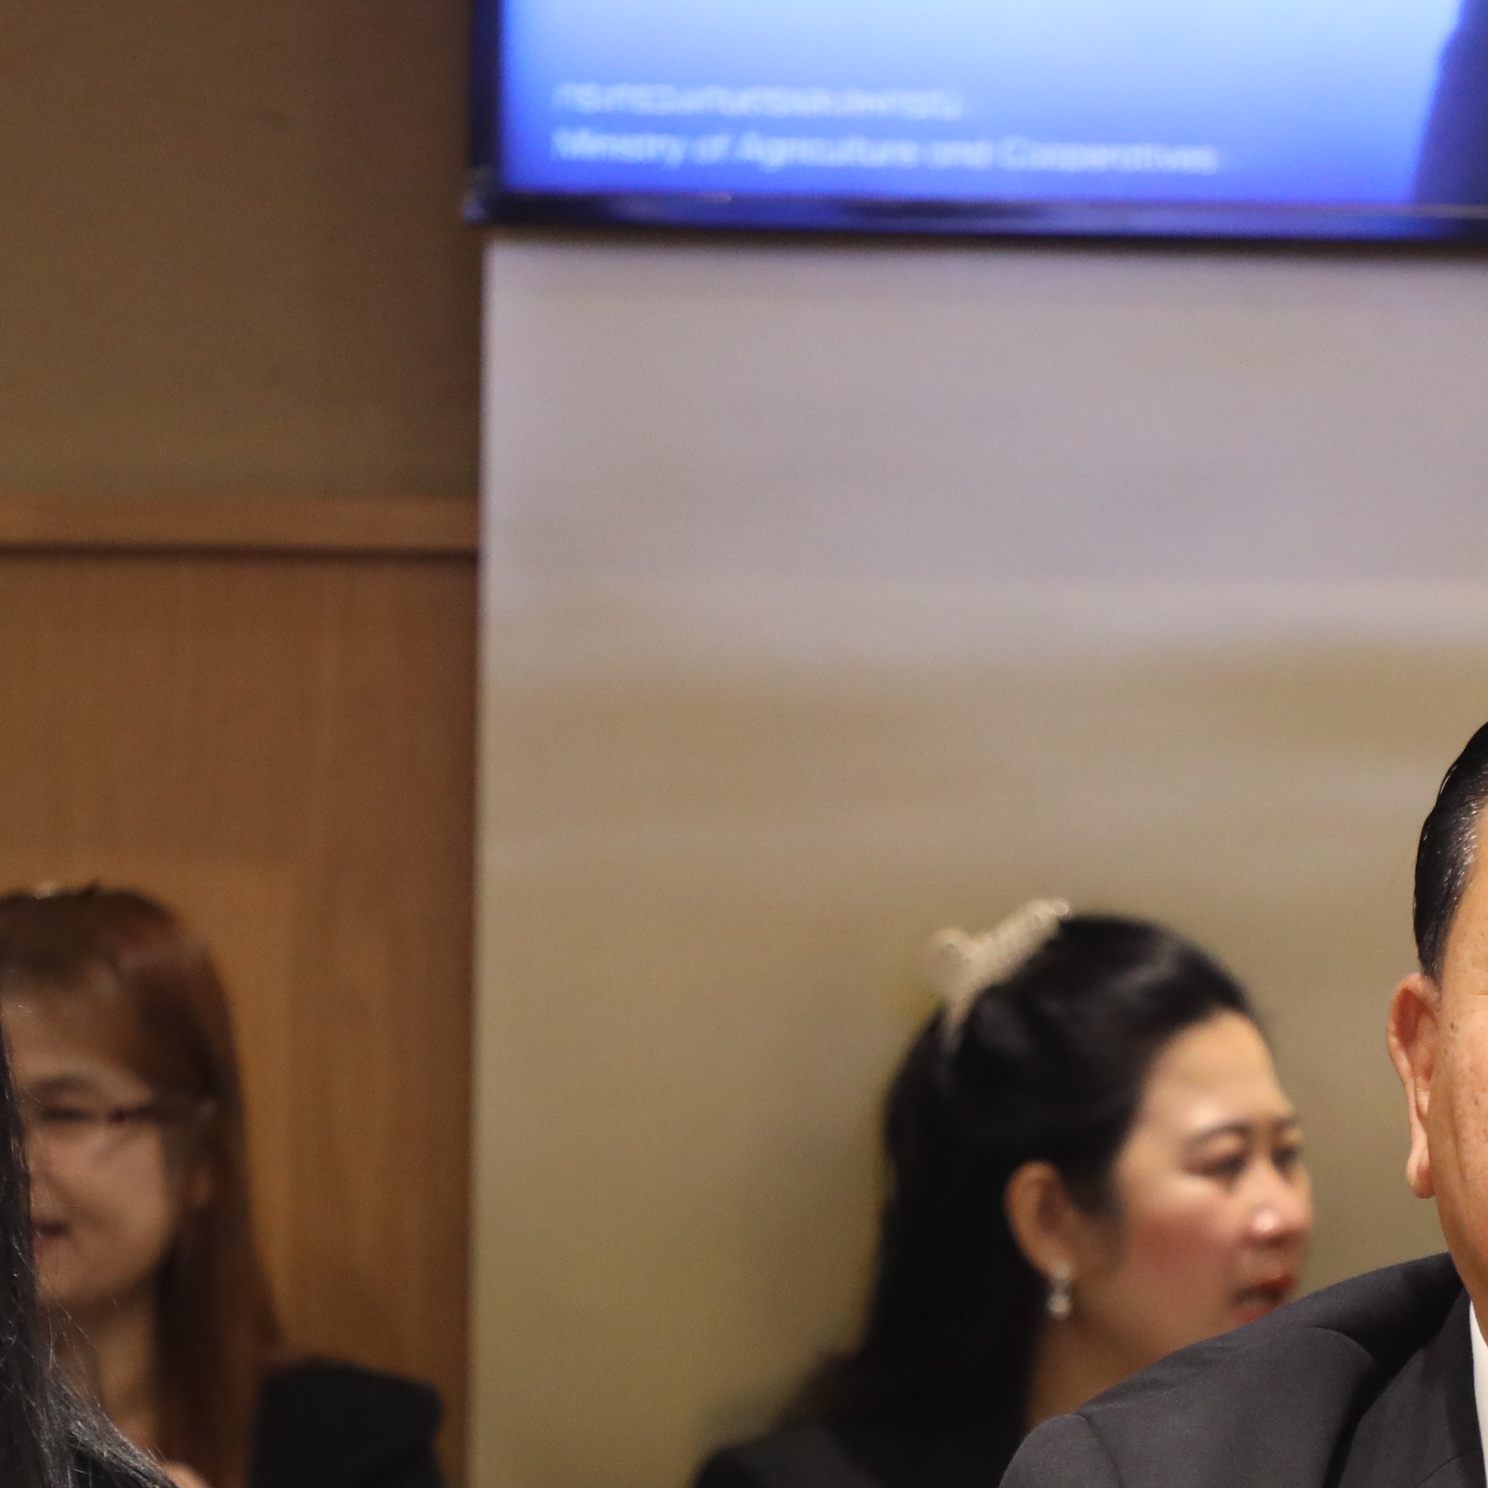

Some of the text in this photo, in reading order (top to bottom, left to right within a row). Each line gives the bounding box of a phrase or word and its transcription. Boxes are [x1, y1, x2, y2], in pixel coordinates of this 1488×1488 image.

[553, 128, 686, 169] Ministry
[691, 131, 731, 166] of
[928, 137, 994, 170] and
